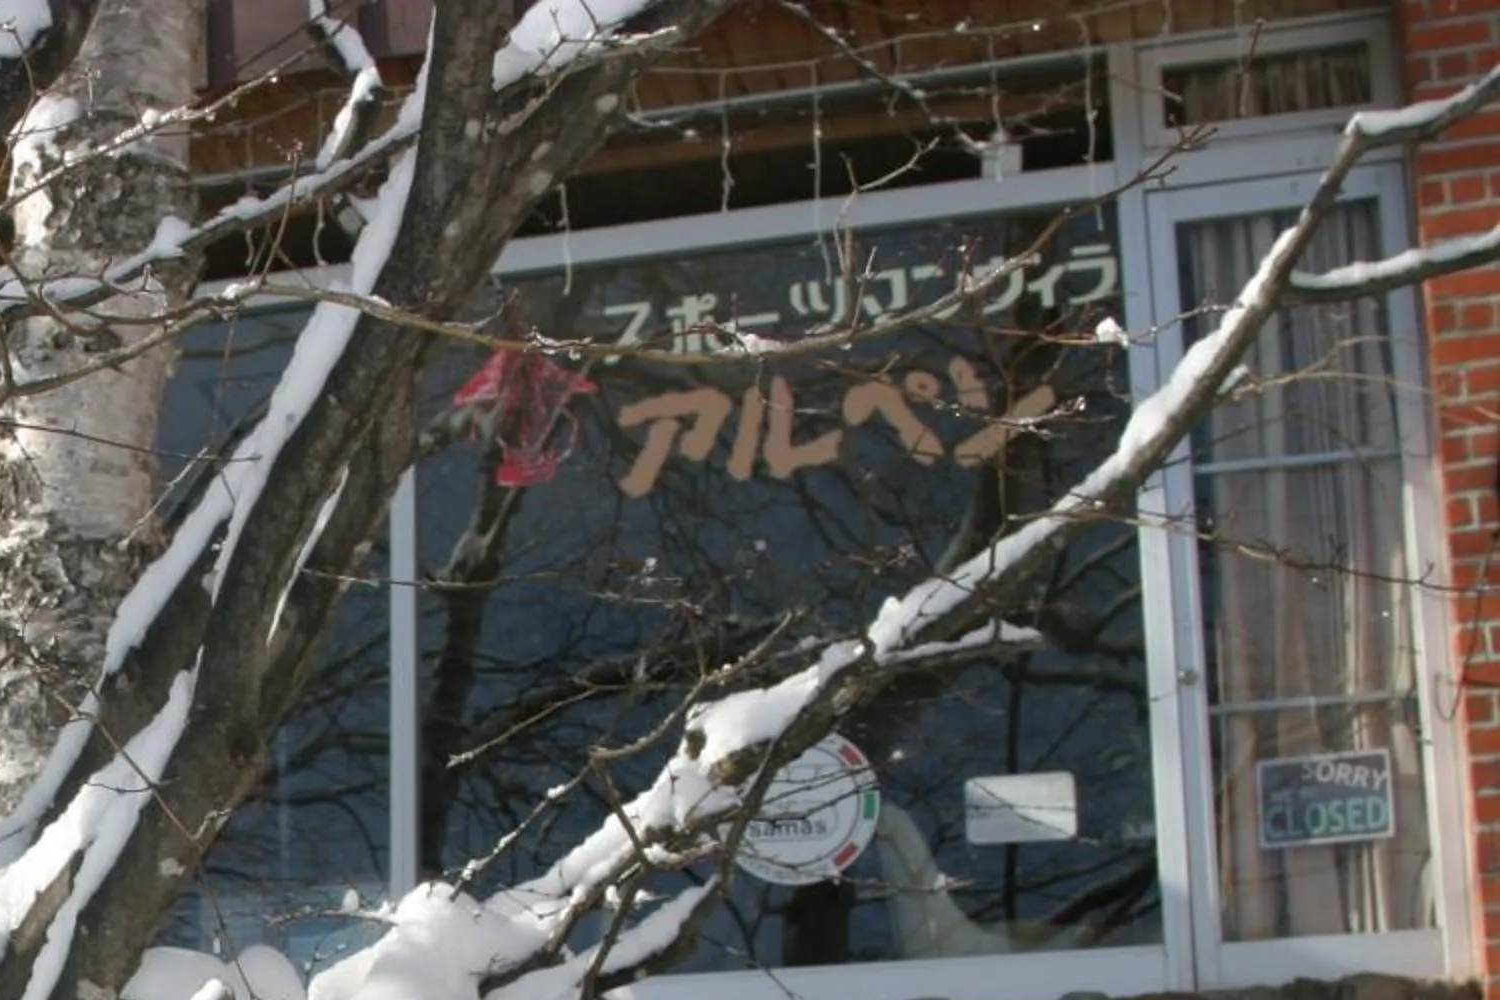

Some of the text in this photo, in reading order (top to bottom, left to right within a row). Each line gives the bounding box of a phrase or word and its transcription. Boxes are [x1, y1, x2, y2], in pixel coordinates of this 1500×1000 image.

[618, 357, 1056, 498] アルペン
[1300, 760, 1388, 792] SORRY
[1265, 796, 1389, 839] CLOSED
